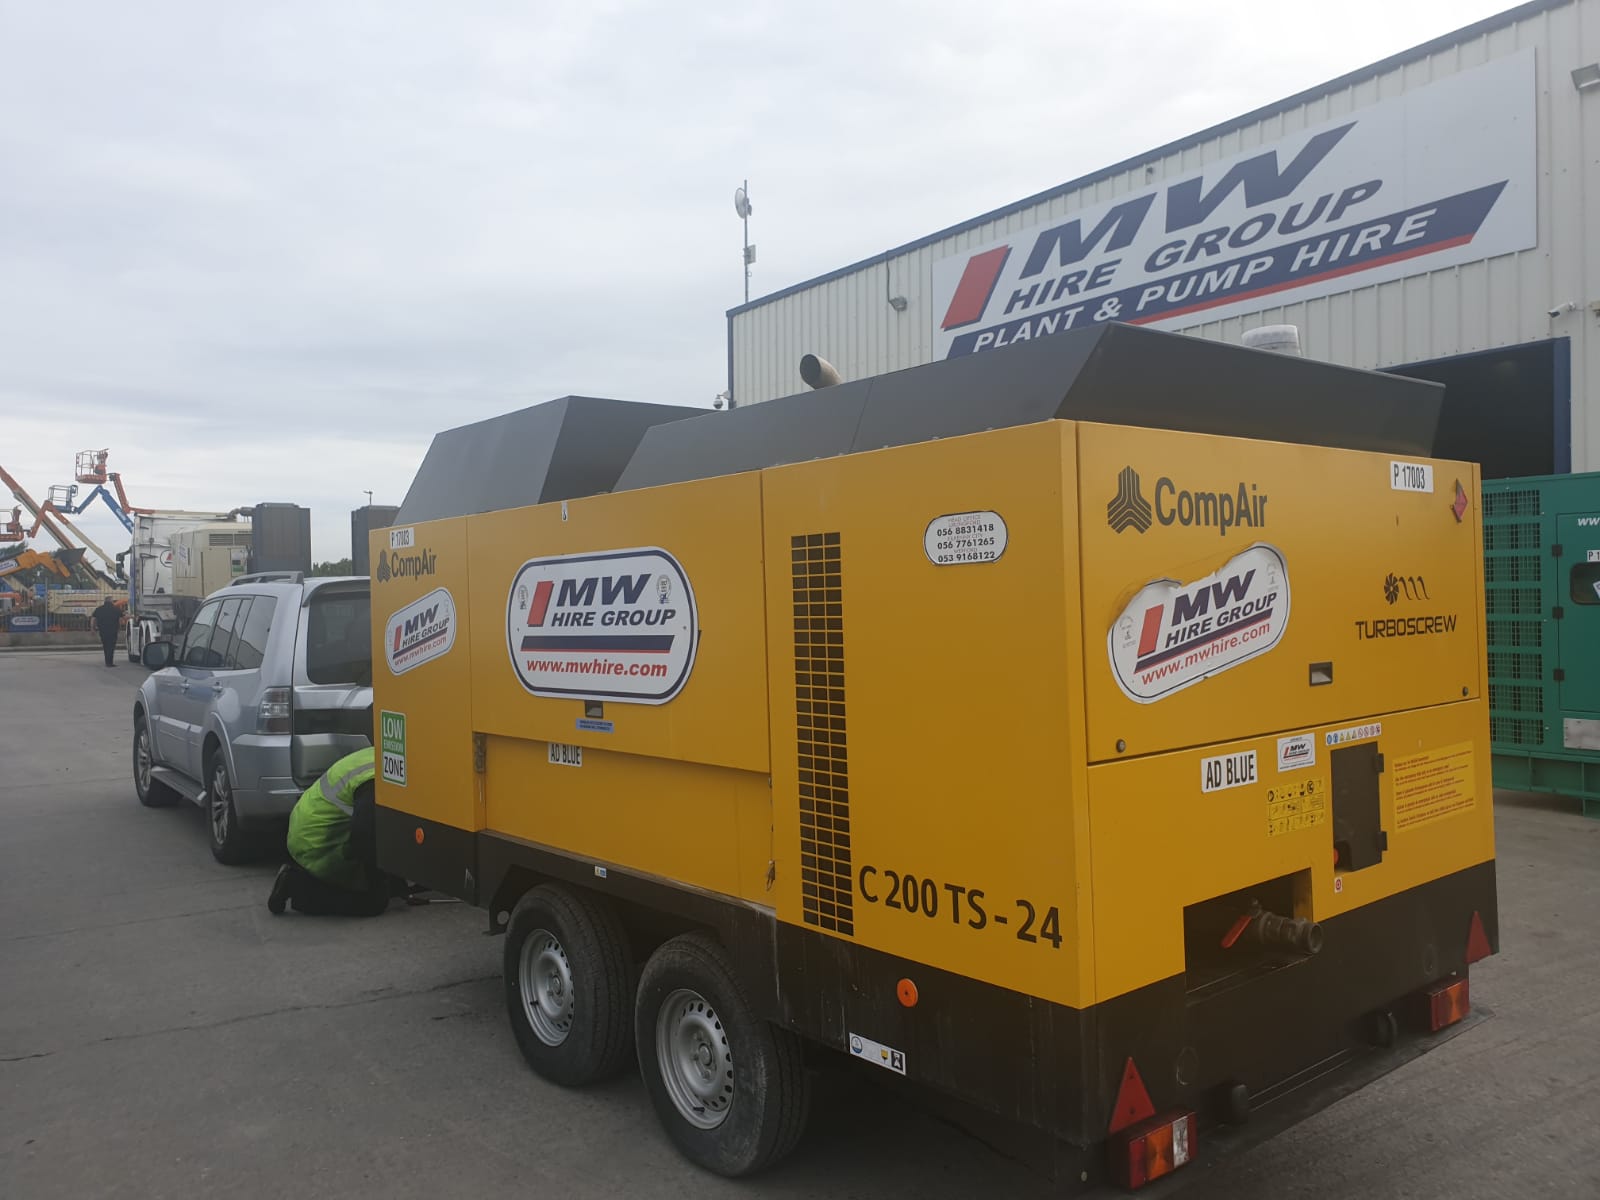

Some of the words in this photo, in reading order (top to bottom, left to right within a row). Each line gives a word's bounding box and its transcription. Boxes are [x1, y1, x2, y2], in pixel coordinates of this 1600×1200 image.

[1018, 120, 1358, 281] MW
[1003, 258, 1122, 315] HIRE
[1144, 179, 1383, 273] GROUP
[973, 306, 1084, 353] PLANT
[1093, 297, 1122, 321] &
[1136, 256, 1275, 311] PUMP
[1289, 208, 1437, 272] HIRE
[1393, 464, 1399, 486] P
[1402, 465, 1425, 489] 17003
[1154, 476, 1268, 536] CompAir
[937, 528, 953, 537] 056
[955, 524, 994, 534] 8831418
[937, 541, 953, 550] 056
[956, 537, 995, 548] 7761265
[391, 547, 437, 581] CompAir
[938, 555, 954, 563] 053
[956, 552, 995, 561] 9168122
[556, 573, 652, 607] MW
[1171, 569, 1257, 627] MW
[402, 632, 421, 648] HIRE
[422, 617, 450, 638] GROUP
[405, 603, 440, 637] MW
[551, 611, 596, 627] HIRE
[601, 608, 676, 626] GROUP
[1165, 616, 1213, 648] HIRE
[1217, 592, 1277, 627] GROUP
[1355, 614, 1457, 640] TURBOSCREW
[526, 657, 668, 677] www.mwhire.com
[1142, 623, 1270, 685] www.mwhire.com
[383, 716, 403, 740] LOW
[384, 756, 404, 778] ZONE
[551, 743, 560, 762] AD
[562, 743, 580, 765] BLUE
[1206, 760, 1222, 789] AD
[1227, 754, 1255, 785] BLUE
